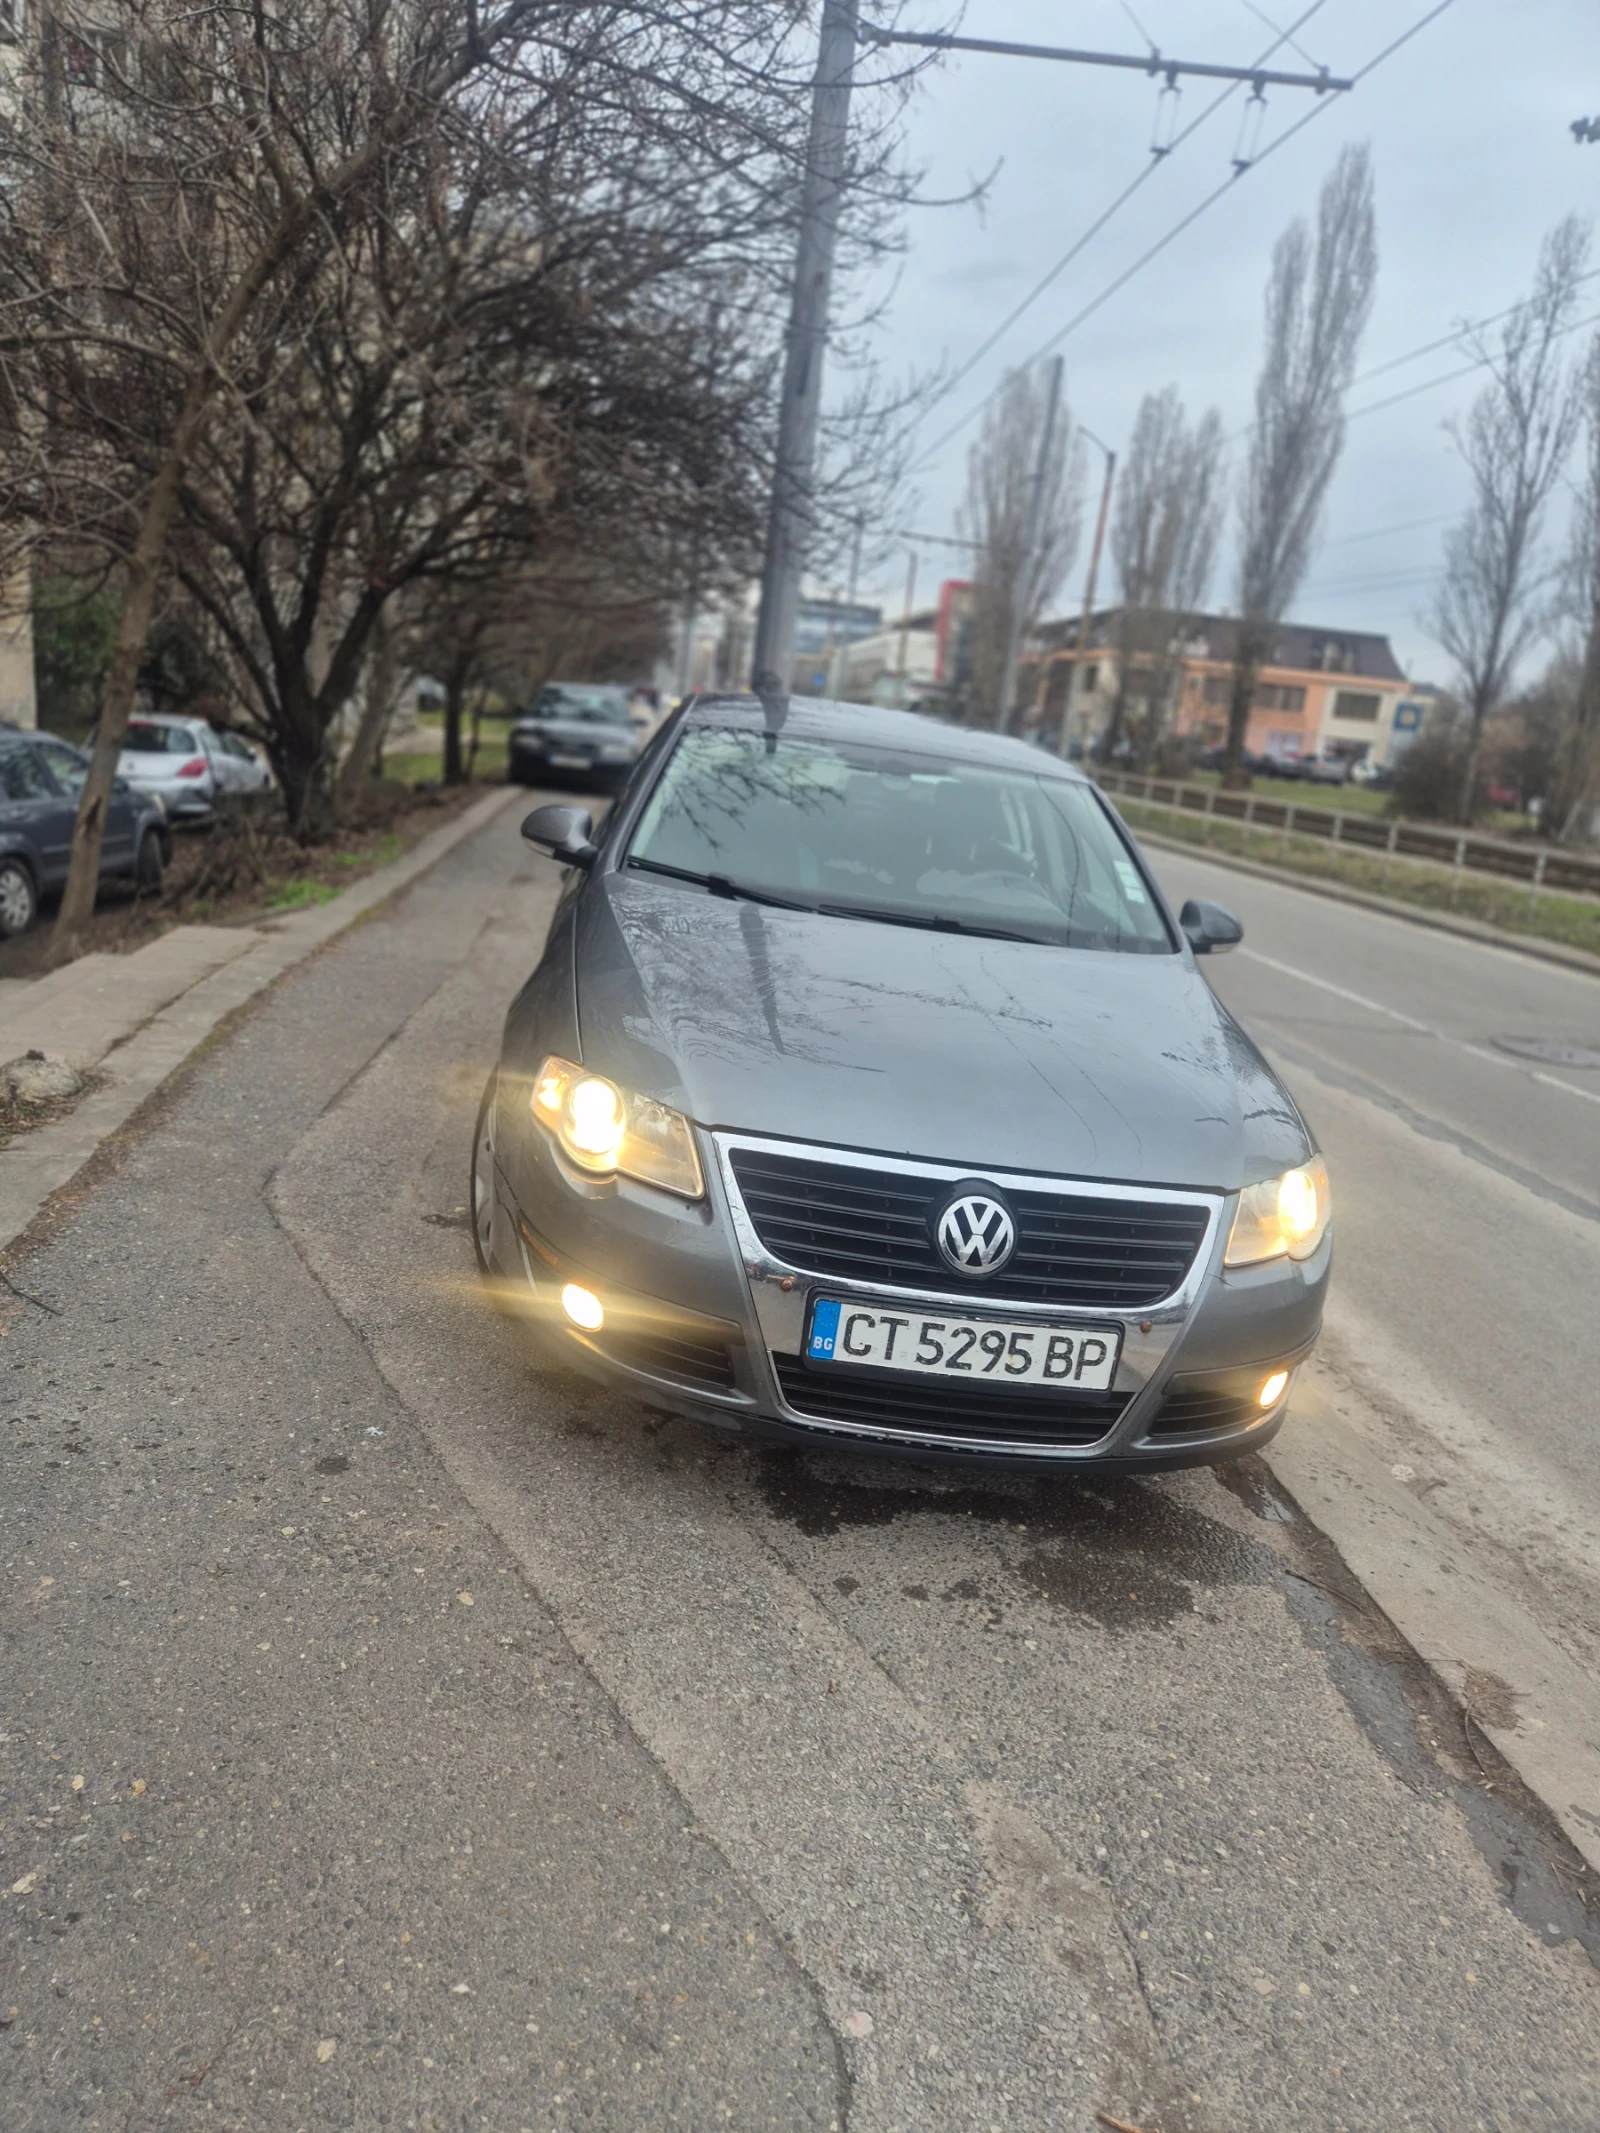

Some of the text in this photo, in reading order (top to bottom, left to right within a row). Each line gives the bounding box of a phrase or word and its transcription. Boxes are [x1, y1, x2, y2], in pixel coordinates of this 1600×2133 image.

[939, 1196, 1013, 1274] VW
[813, 1335, 834, 1352] BG
[843, 1313, 1108, 1381] CT 5295 BP
